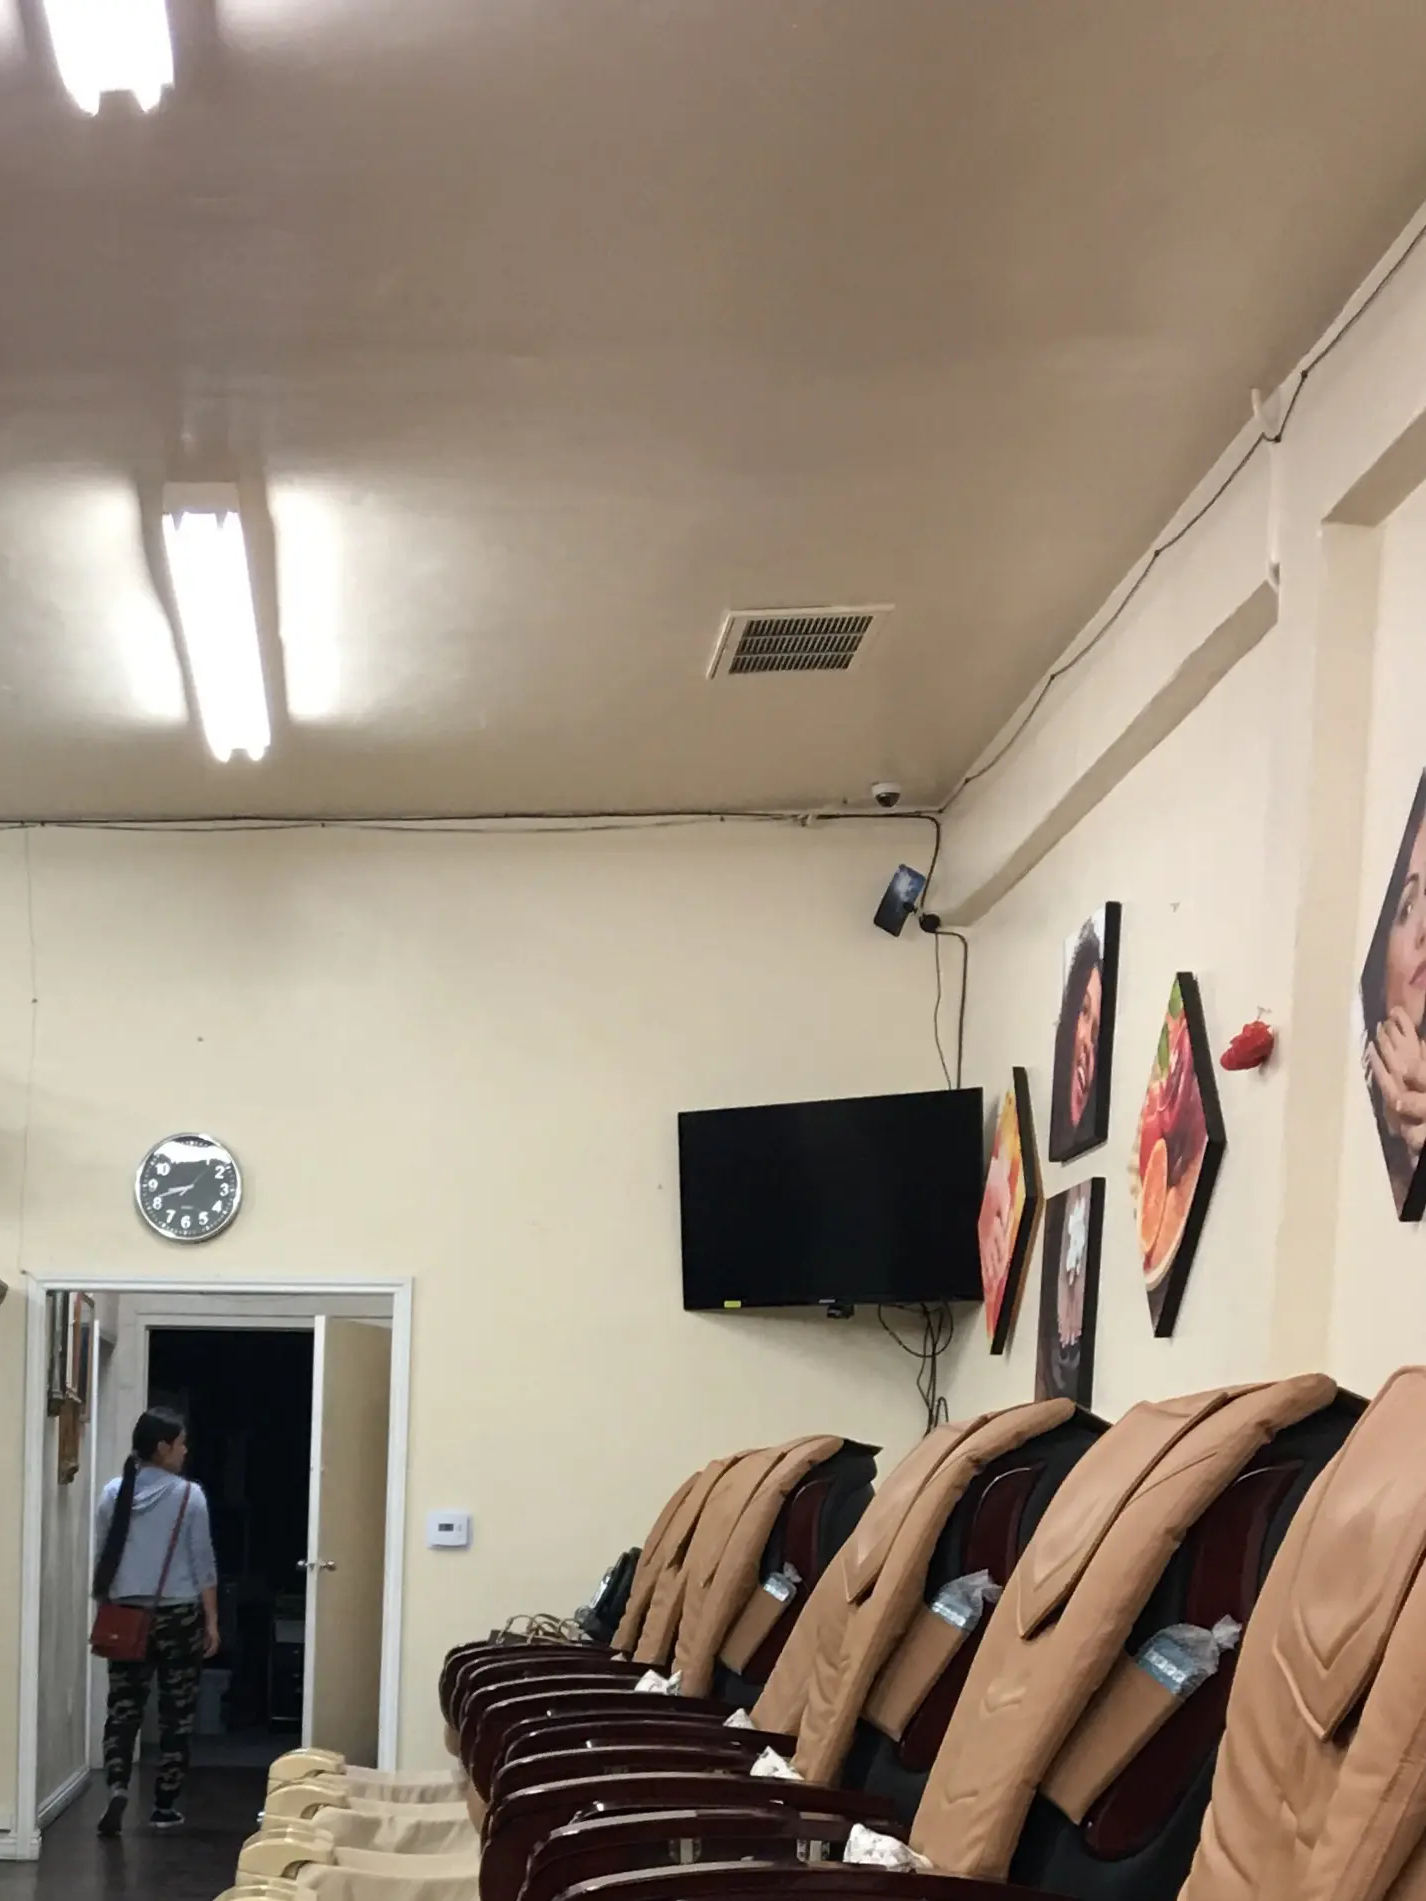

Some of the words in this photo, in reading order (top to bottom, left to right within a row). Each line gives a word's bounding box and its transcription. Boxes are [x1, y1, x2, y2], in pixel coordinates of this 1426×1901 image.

[155, 1162, 171, 1176] 10
[214, 1165, 224, 1179] 2
[148, 1178, 158, 1192] 9
[219, 1182, 229, 1196] 3
[152, 1196, 162, 1210] 8
[211, 1200, 223, 1213] 4
[166, 1209, 176, 1223] 7
[180, 1215, 191, 1229] 6
[198, 1211, 209, 1225] 5
